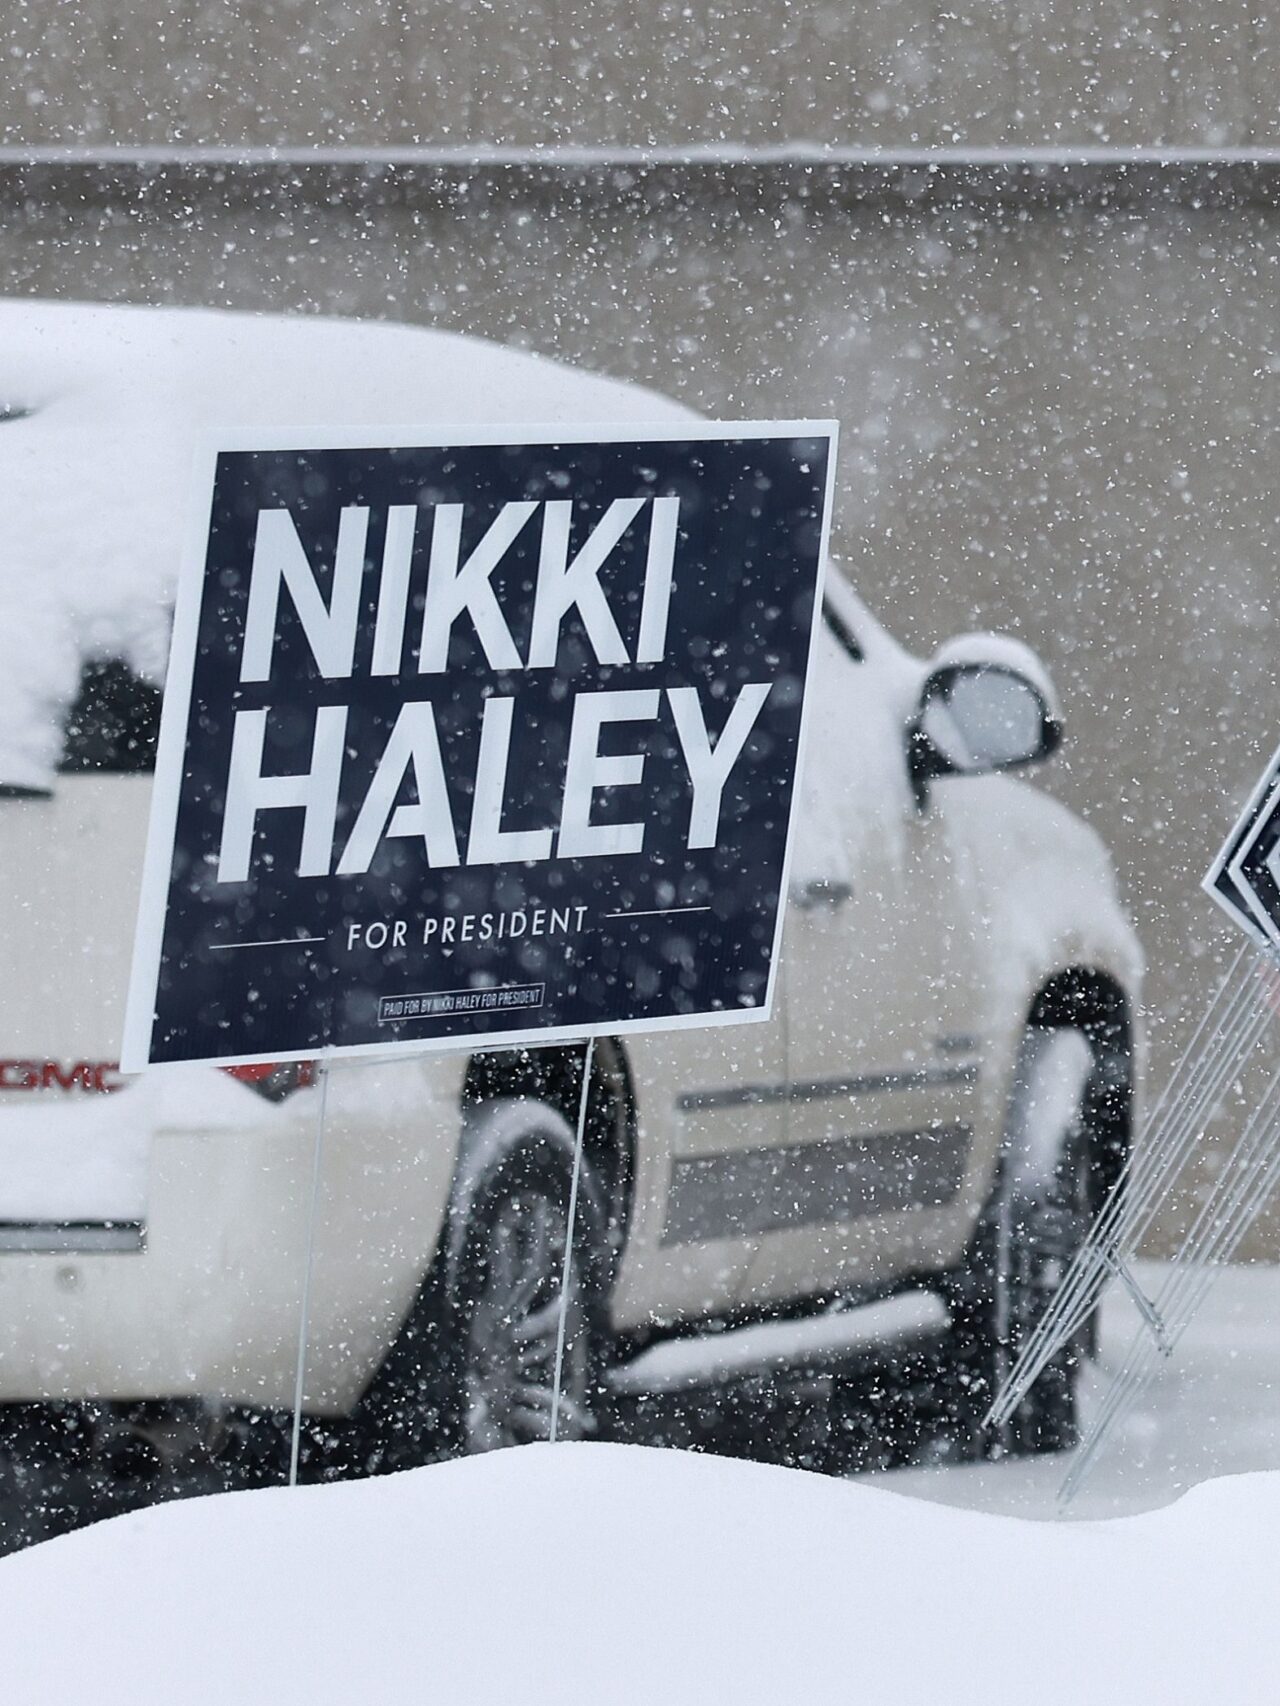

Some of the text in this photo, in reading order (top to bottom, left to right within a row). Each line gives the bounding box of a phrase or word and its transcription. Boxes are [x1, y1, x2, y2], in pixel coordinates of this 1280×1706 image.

[239, 496, 680, 682] NIKKI
[216, 683, 773, 883] HALEY
[347, 906, 588, 950] FOR PRESIDENT
[383, 1001, 402, 1016] PAID
[404, 1000, 420, 1015] FOR
[421, 999, 432, 1014] BY
[455, 994, 481, 1010] HALEY
[481, 993, 498, 1008] FOR
[498, 989, 540, 1006] PRESIDENT
[0, 1060, 124, 1092] GMC
